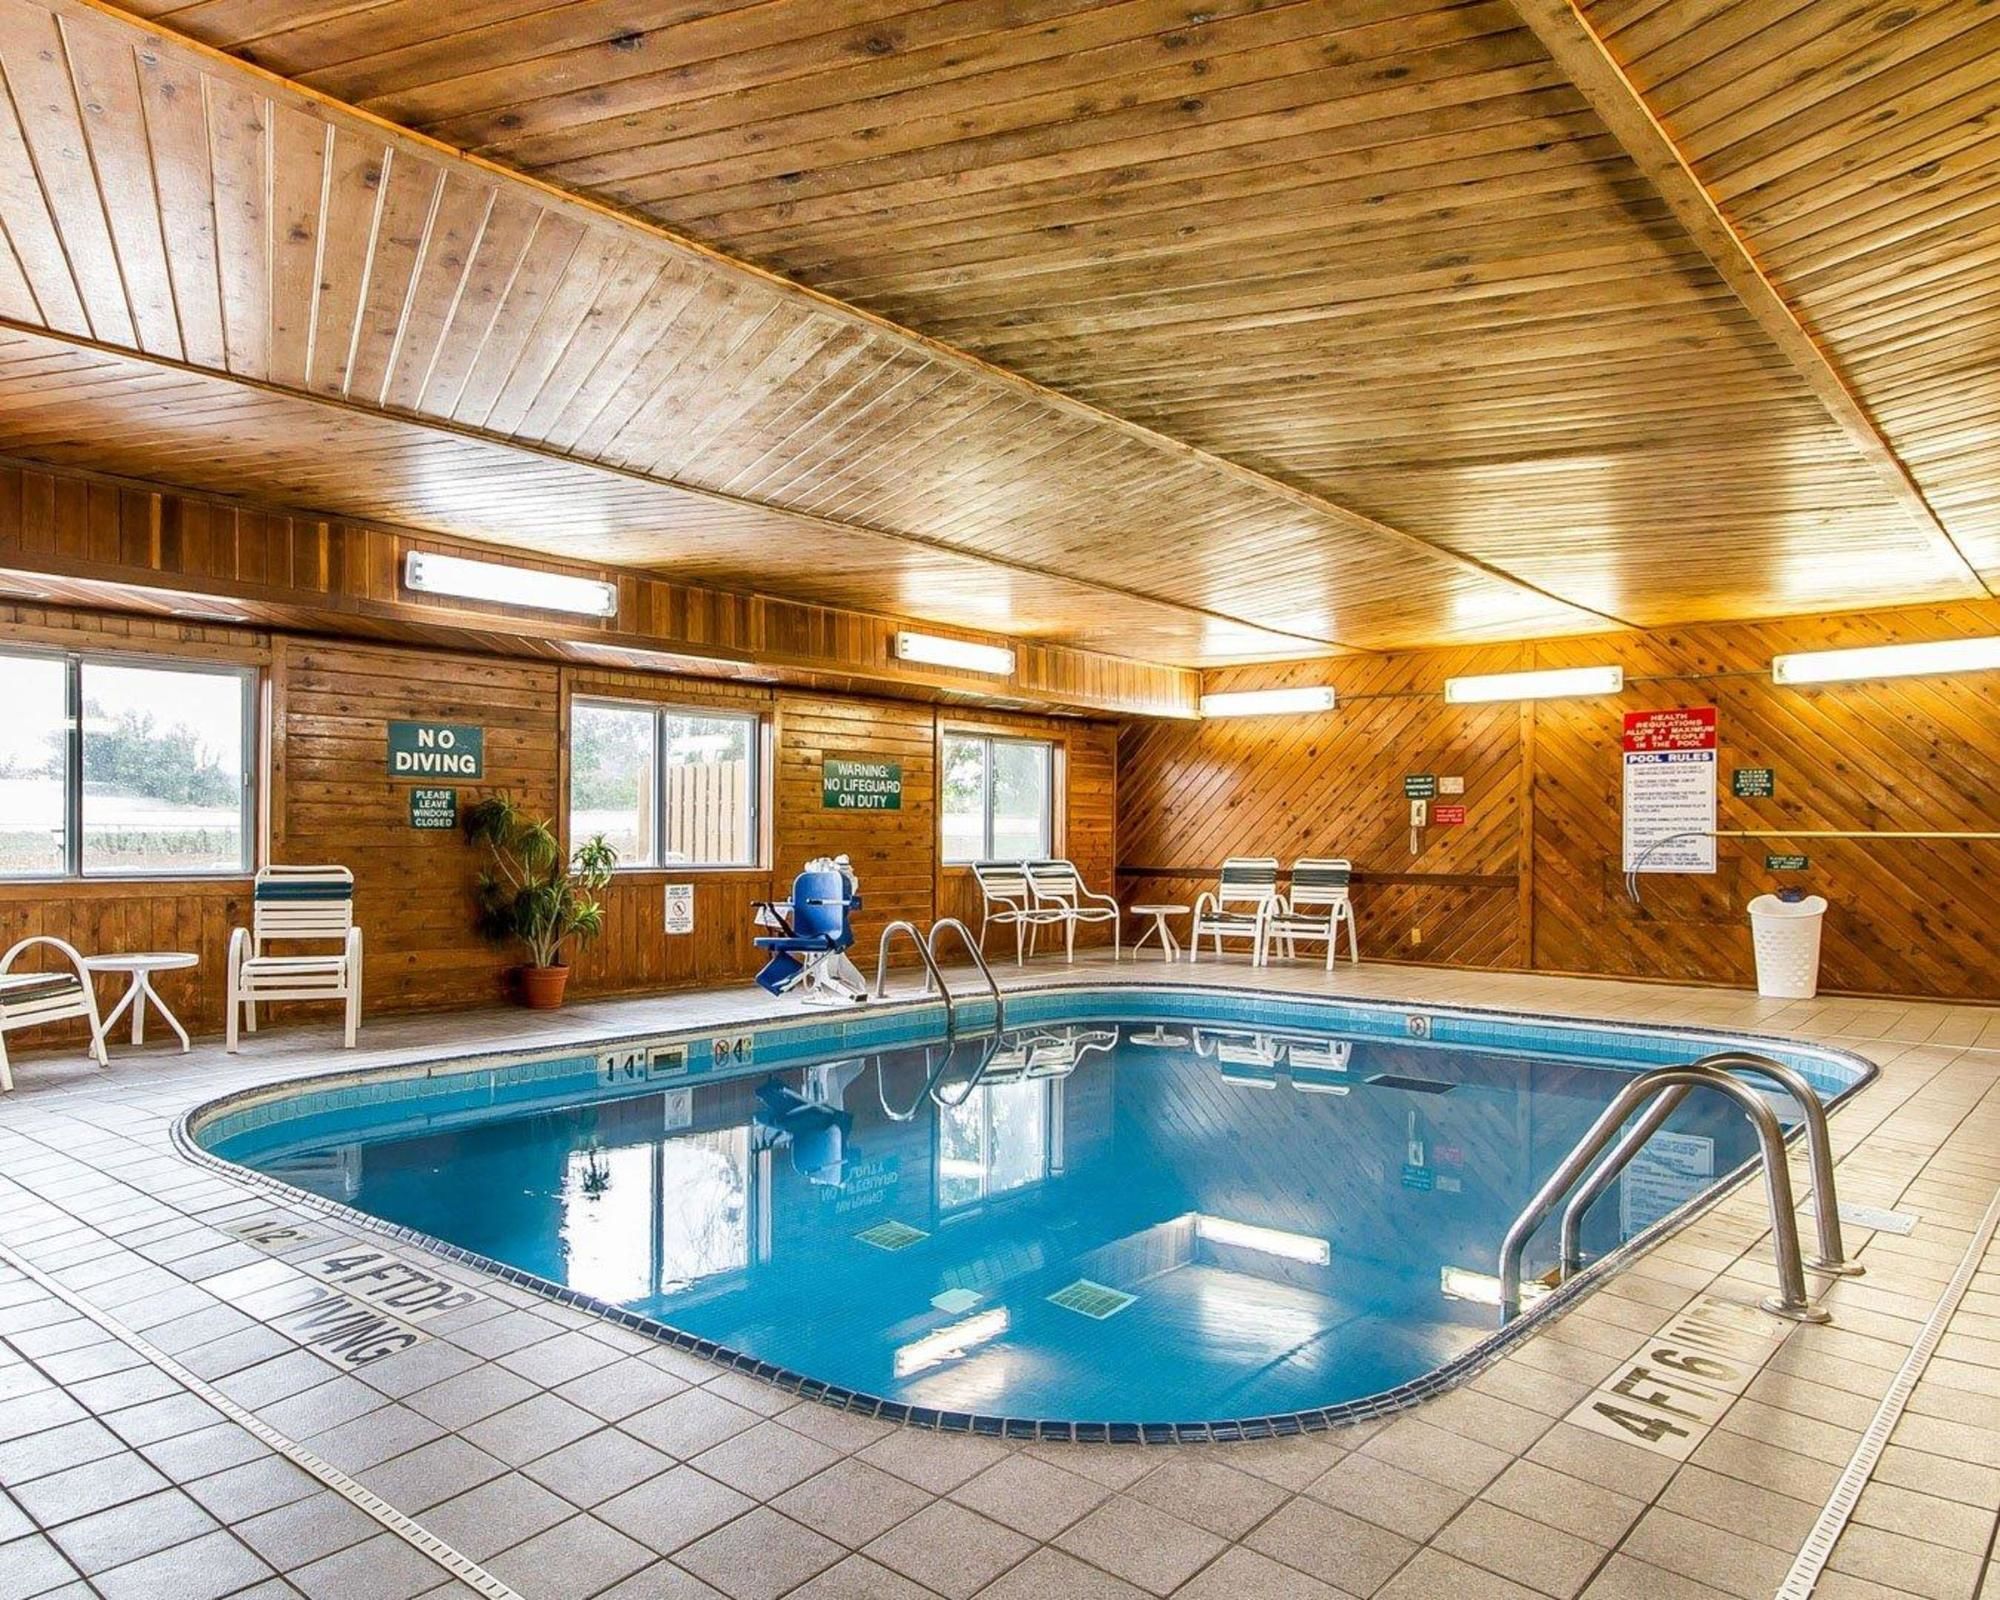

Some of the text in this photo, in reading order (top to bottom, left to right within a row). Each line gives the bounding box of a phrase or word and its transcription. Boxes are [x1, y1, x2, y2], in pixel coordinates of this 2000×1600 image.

[1650, 713, 1688, 721] HEALTH
[1635, 719, 1703, 728] REGULATIONS
[418, 729, 455, 749] NO
[1629, 753, 1710, 763] POOL RULES
[396, 752, 476, 774] DIVING
[838, 763, 888, 777] WARNING:
[824, 778, 900, 793] NO LIFEGUARD
[416, 791, 451, 799] PLEASE
[419, 800, 448, 808] LEAVE
[838, 794, 887, 808] ON DUTY
[413, 809, 455, 817] WINDOWS
[415, 818, 453, 826] CLOSED
